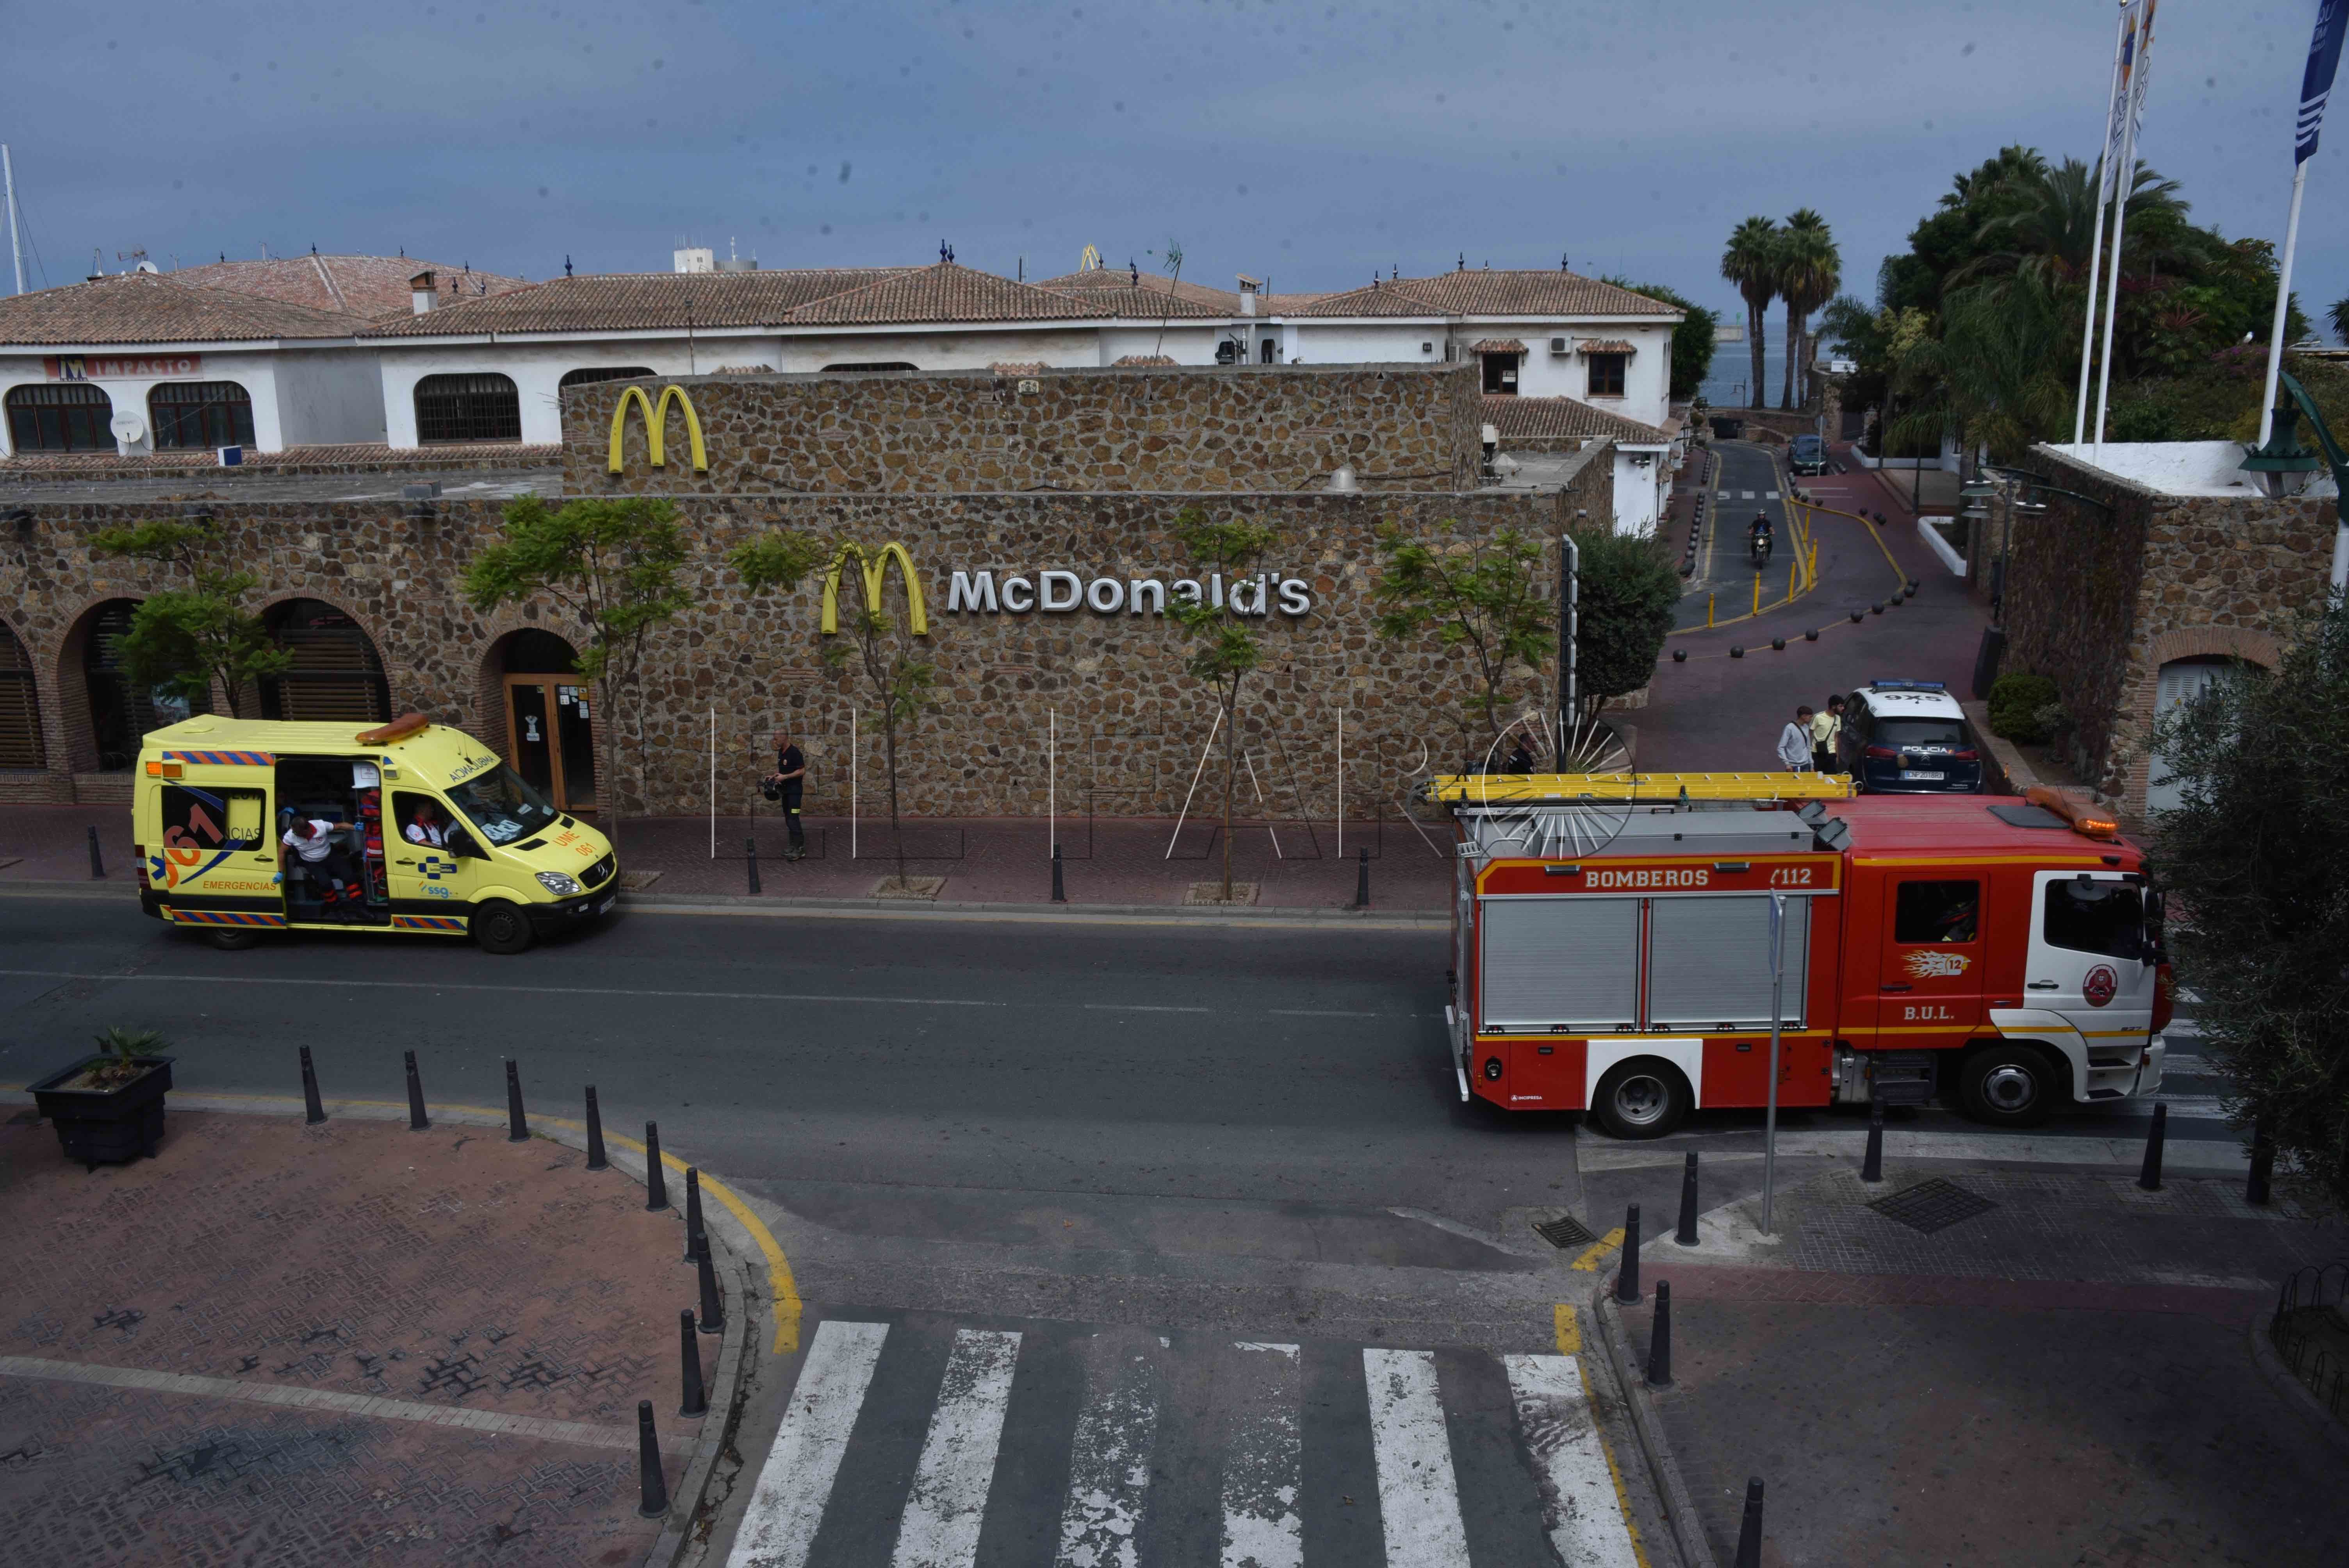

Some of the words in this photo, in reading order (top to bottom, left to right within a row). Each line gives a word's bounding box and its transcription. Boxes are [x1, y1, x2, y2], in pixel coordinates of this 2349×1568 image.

[95, 359, 191, 376] IMPACTO
[948, 570, 1311, 617] McDonald's
[552, 830, 581, 846] UME
[576, 842, 597, 856] 061
[1585, 869, 1709, 888] BOMBEROS
[1781, 868, 1812, 885] 112
[203, 880, 277, 891] EMERGENCIAS
[1949, 959, 1962, 970] 12
[1904, 1005, 1955, 1020] B.U.L.
